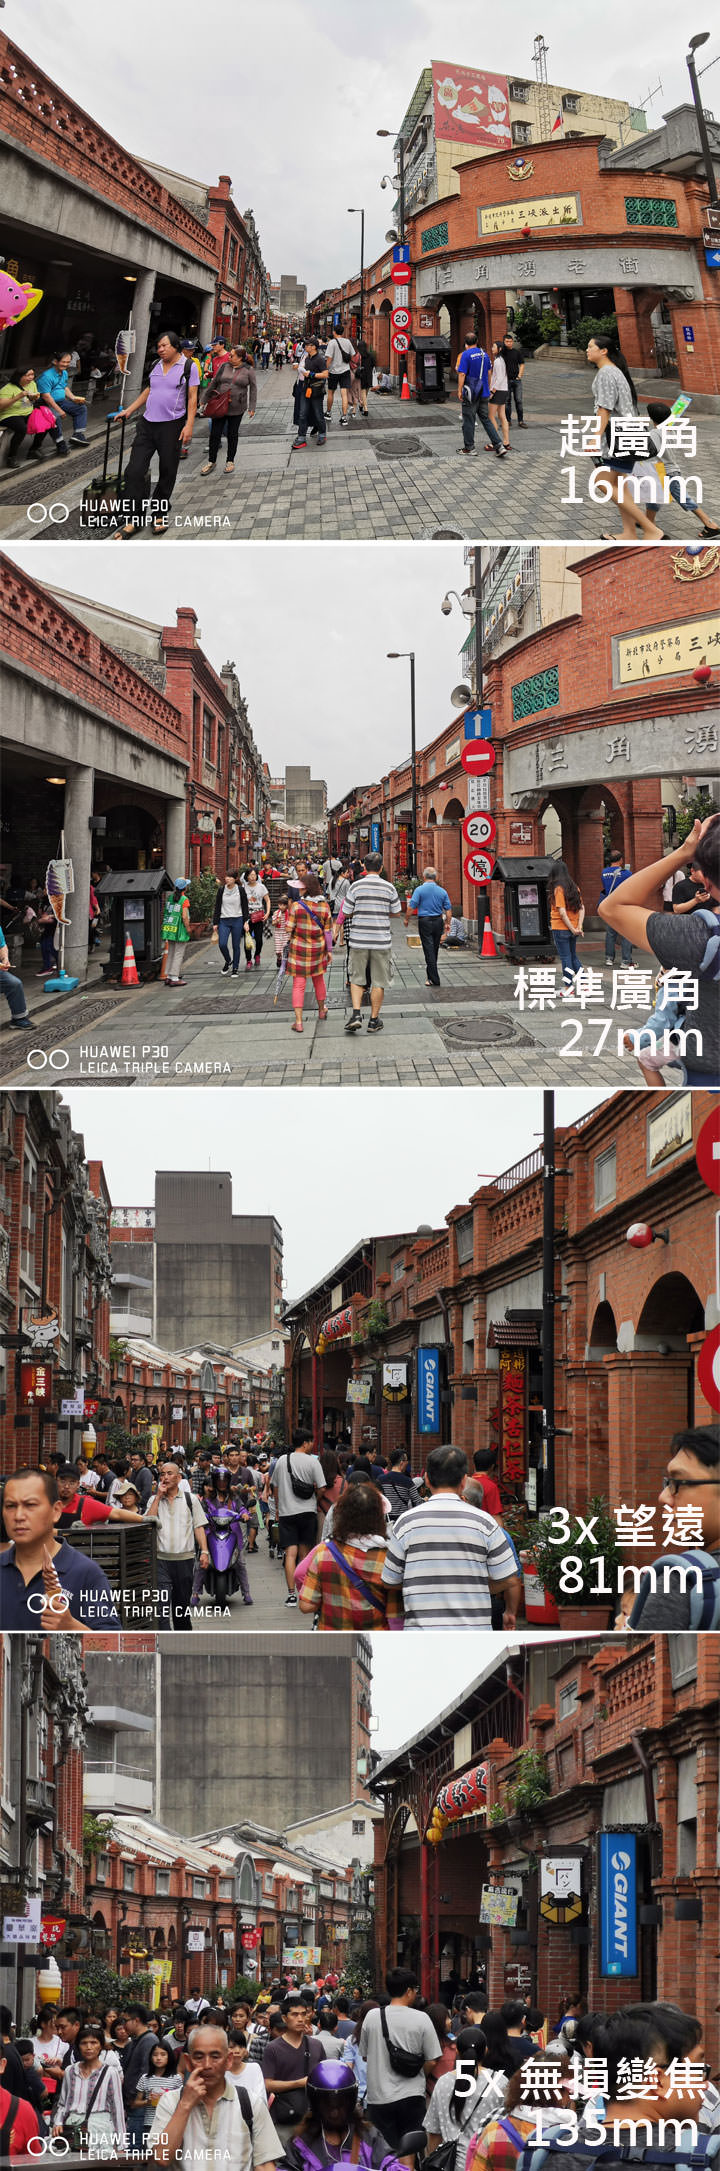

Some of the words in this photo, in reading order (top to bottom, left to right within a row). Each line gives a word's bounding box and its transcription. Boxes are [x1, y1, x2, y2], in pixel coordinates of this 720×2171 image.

[441, 256, 640, 286] 三角湧老街
[395, 314, 408, 323] 20
[469, 824, 489, 837] 20
[471, 860, 487, 877] 停
[425, 1371, 435, 1423] GIANT
[614, 1872, 629, 1958] GIANT
